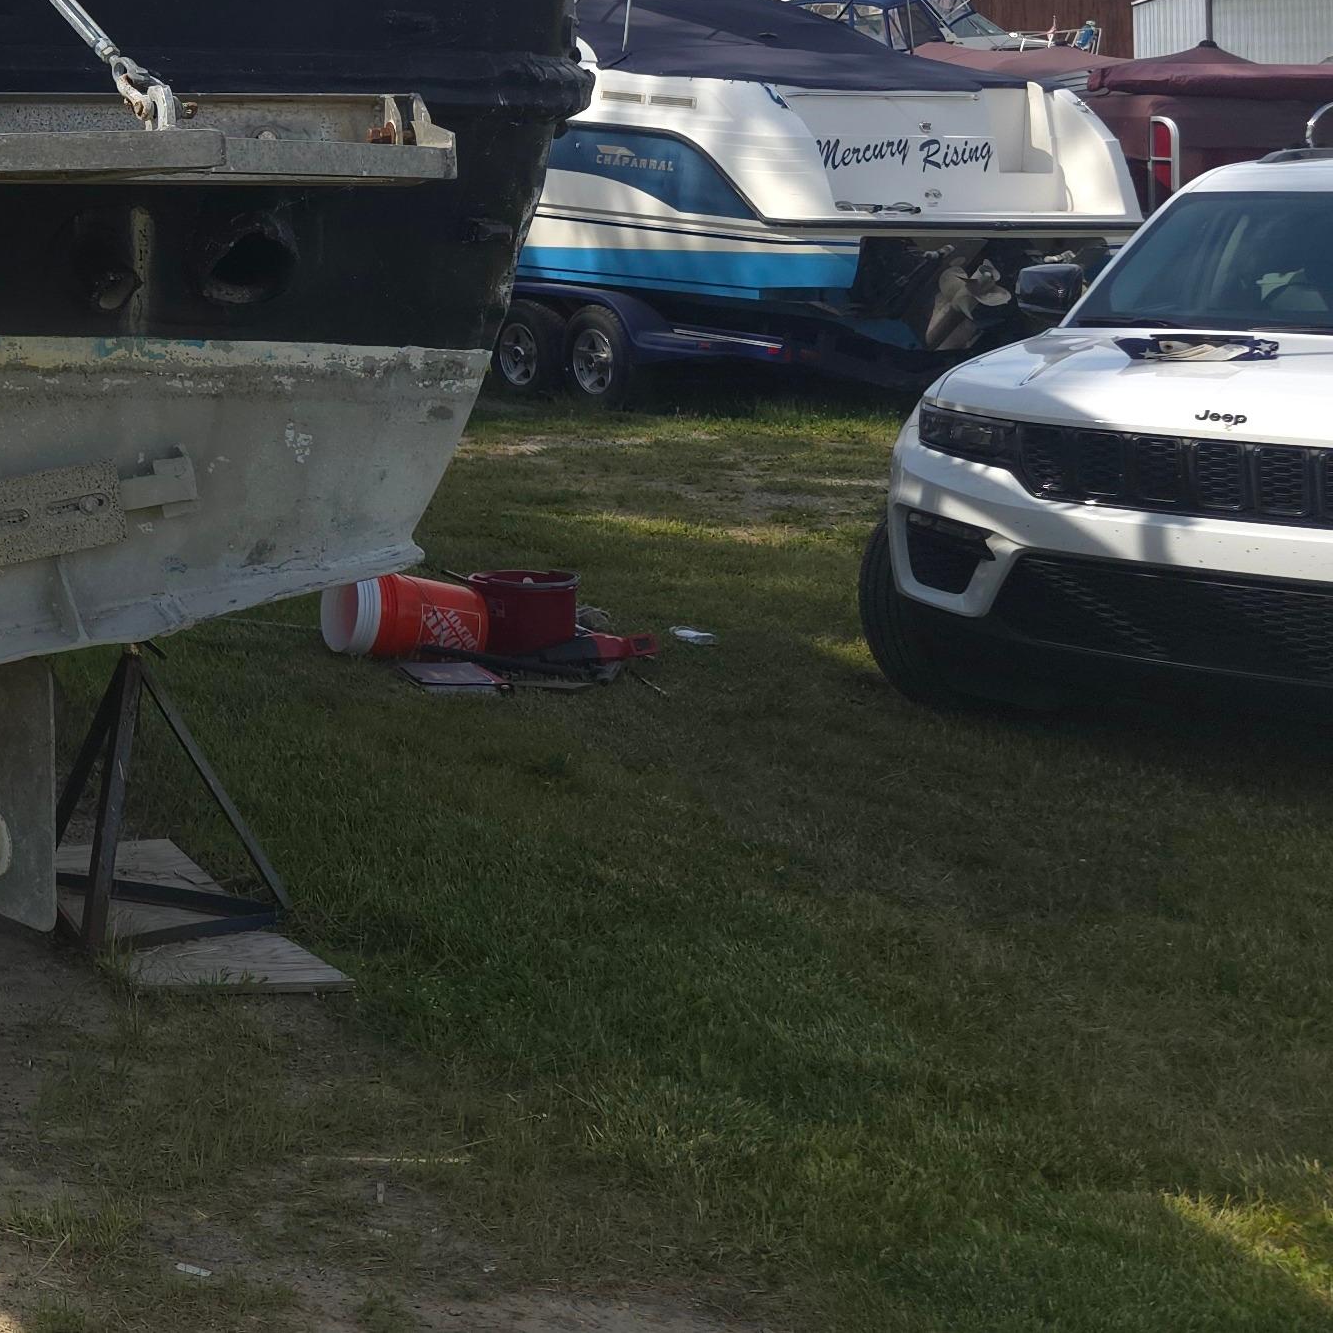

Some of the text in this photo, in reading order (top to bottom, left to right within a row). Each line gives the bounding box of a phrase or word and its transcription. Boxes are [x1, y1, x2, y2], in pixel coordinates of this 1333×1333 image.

[596, 153, 675, 172] CHAPARRAL
[816, 138, 994, 173] Mercury Rising
[1194, 409, 1248, 426] Jeep
